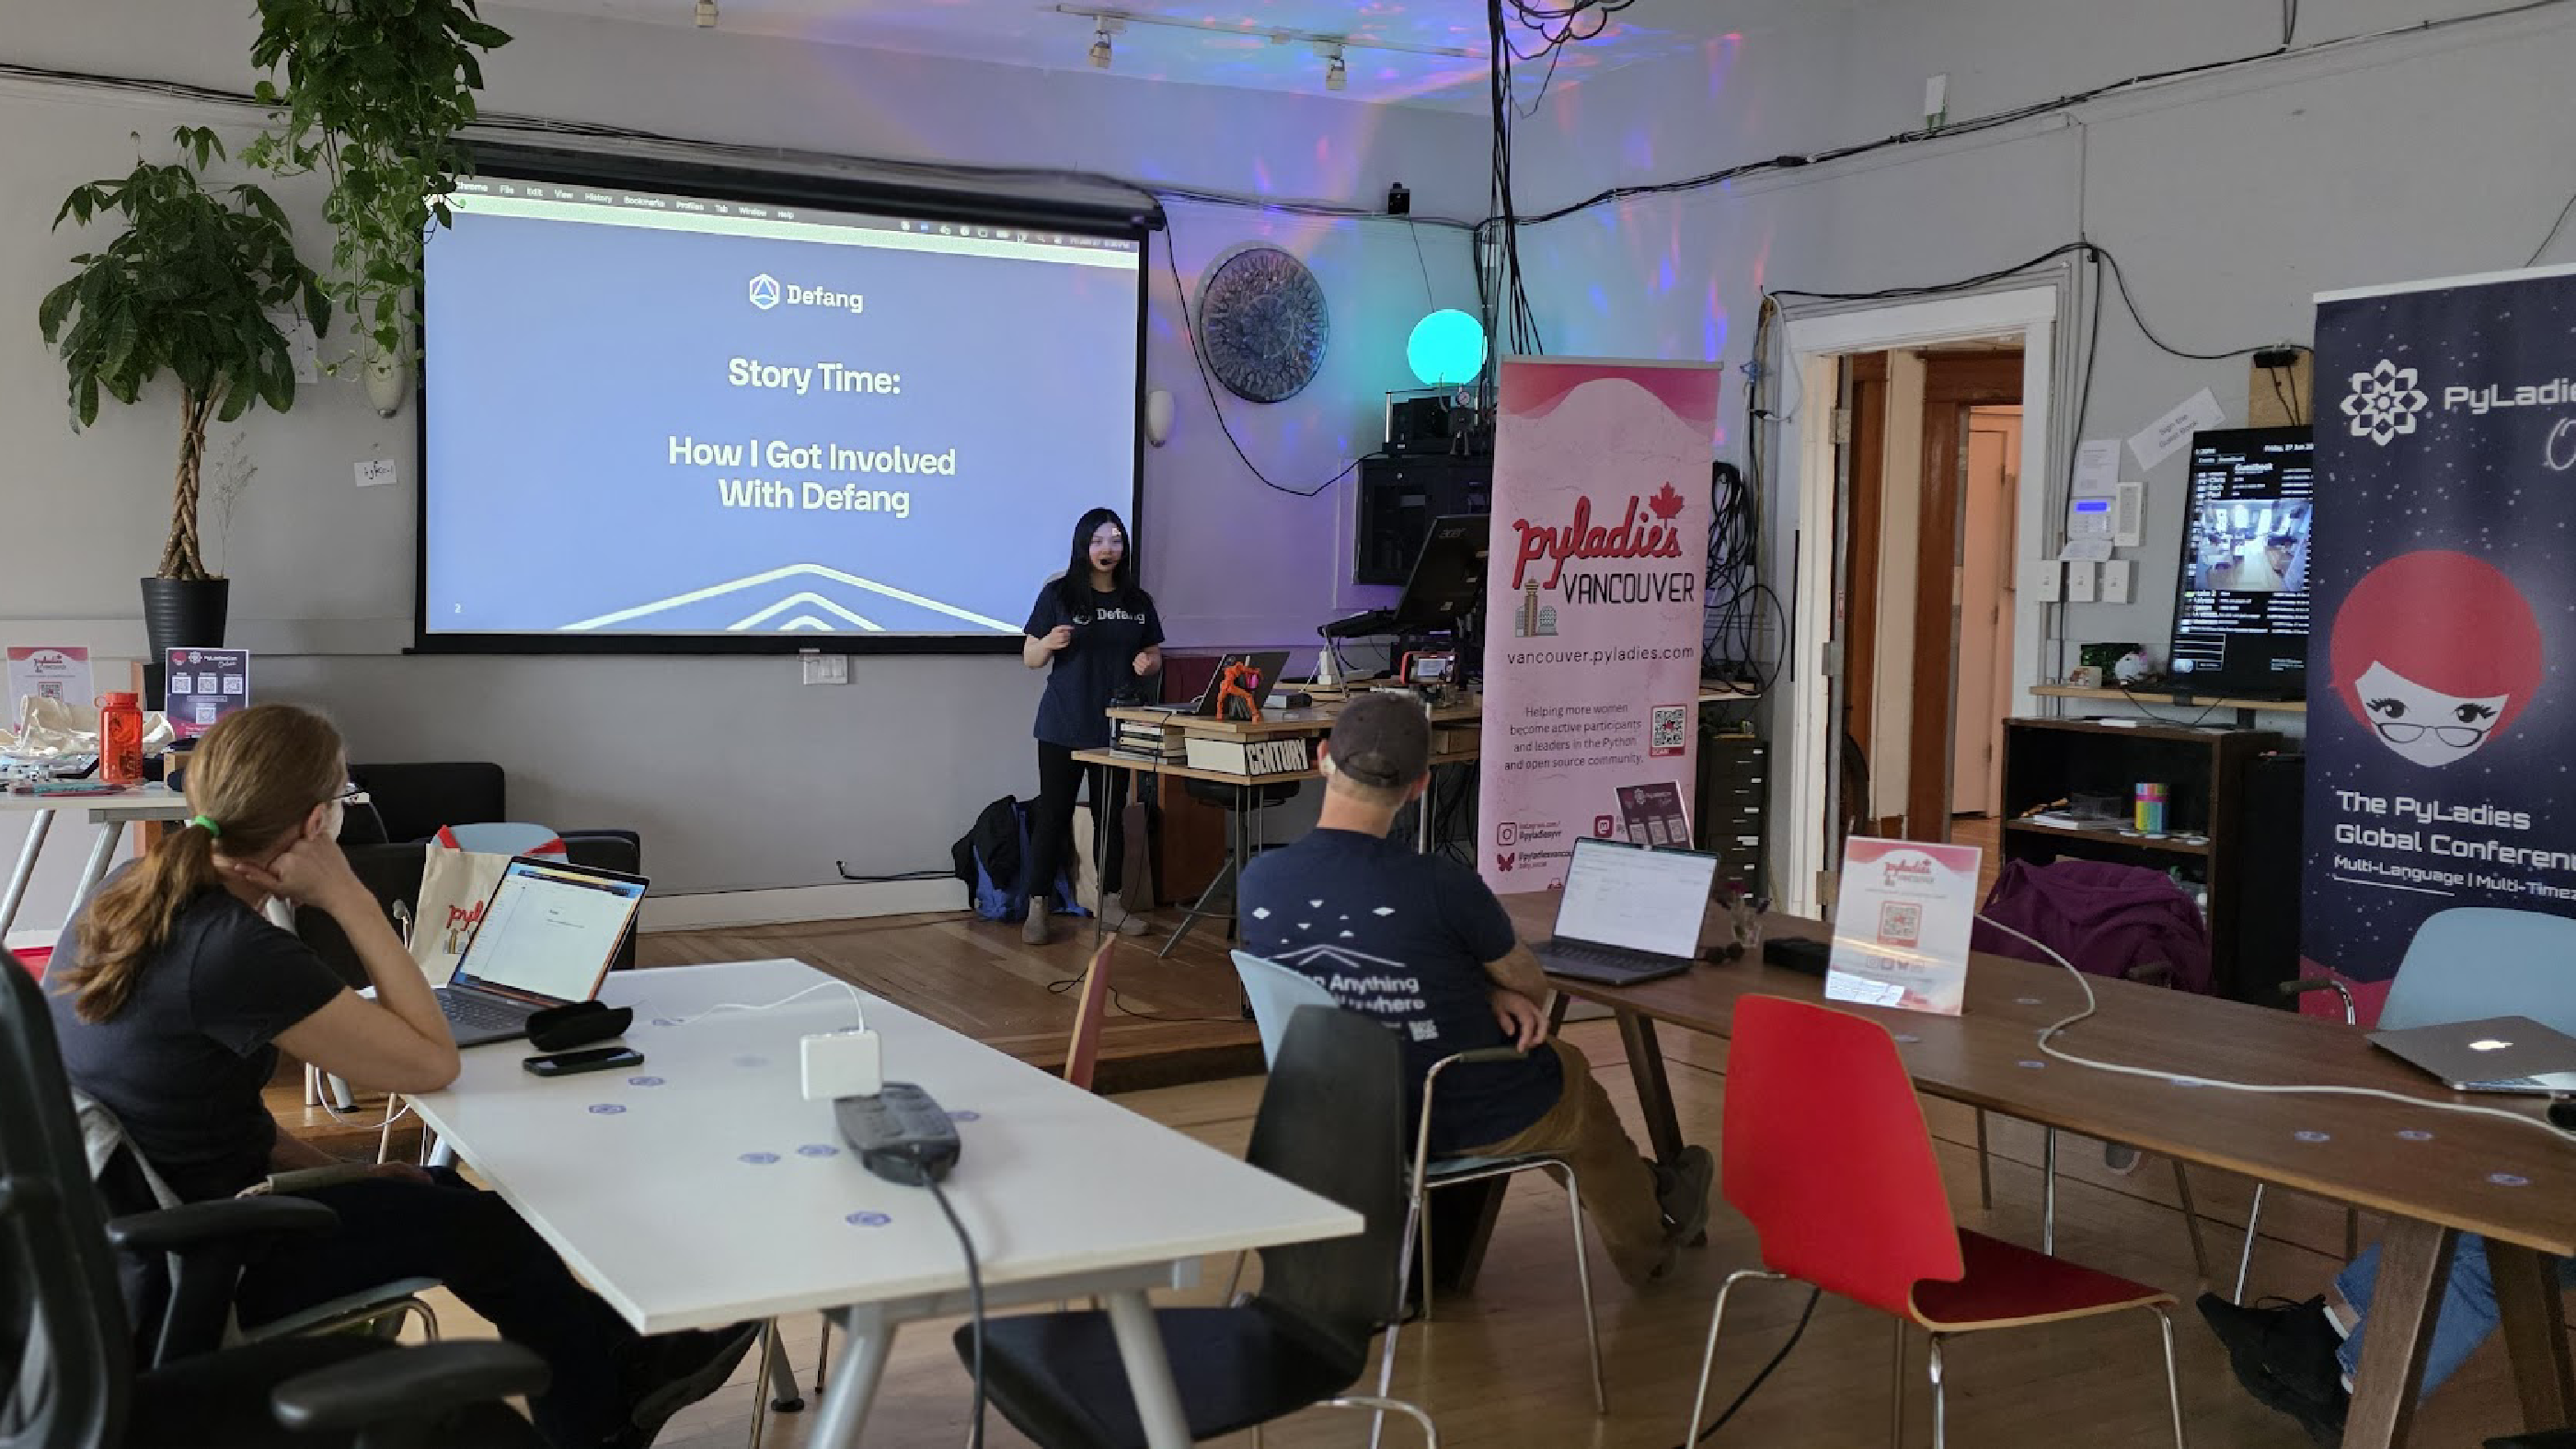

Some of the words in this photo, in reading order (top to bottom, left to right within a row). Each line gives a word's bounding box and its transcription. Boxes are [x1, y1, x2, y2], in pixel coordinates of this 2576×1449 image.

[555, 189, 574, 199] View
[584, 192, 613, 203] History
[623, 195, 666, 208] Bookmarks
[676, 200, 705, 211] Profiles
[739, 206, 767, 217] Window
[787, 284, 864, 314] Defang
[729, 357, 813, 396] Story
[817, 362, 902, 395] Time:
[669, 435, 742, 466] How
[750, 439, 759, 468] I
[766, 440, 822, 470] Got
[830, 443, 956, 476] Involved
[719, 478, 795, 509] With
[802, 481, 910, 519] Defang
[1512, 495, 1684, 591] pyladies
[1562, 572, 1695, 604] VANCOUVER
[1507, 646, 1695, 666] vancouver.pyladies.com
[1525, 706, 1564, 719] Helping
[1565, 706, 1592, 716] more
[1593, 704, 1628, 715] women
[1510, 724, 1550, 735] become
[1551, 722, 1581, 734] active
[1583, 719, 1642, 734] participants
[1513, 742, 1533, 753] and
[1535, 740, 1570, 752] leaders
[1572, 739, 1582, 749] in
[1583, 738, 1601, 749] the
[1602, 736, 1638, 750] Python
[1504, 760, 1524, 771] and
[1525, 758, 1550, 771] open
[1551, 756, 1585, 767] source
[1588, 753, 1644, 766] community.
[2336, 789, 2388, 815] The
[2394, 796, 2531, 831] PyLadies
[2335, 823, 2423, 853] Global
[2334, 855, 2465, 887] Multi-Language
[1329, 972, 1420, 995] Anything
